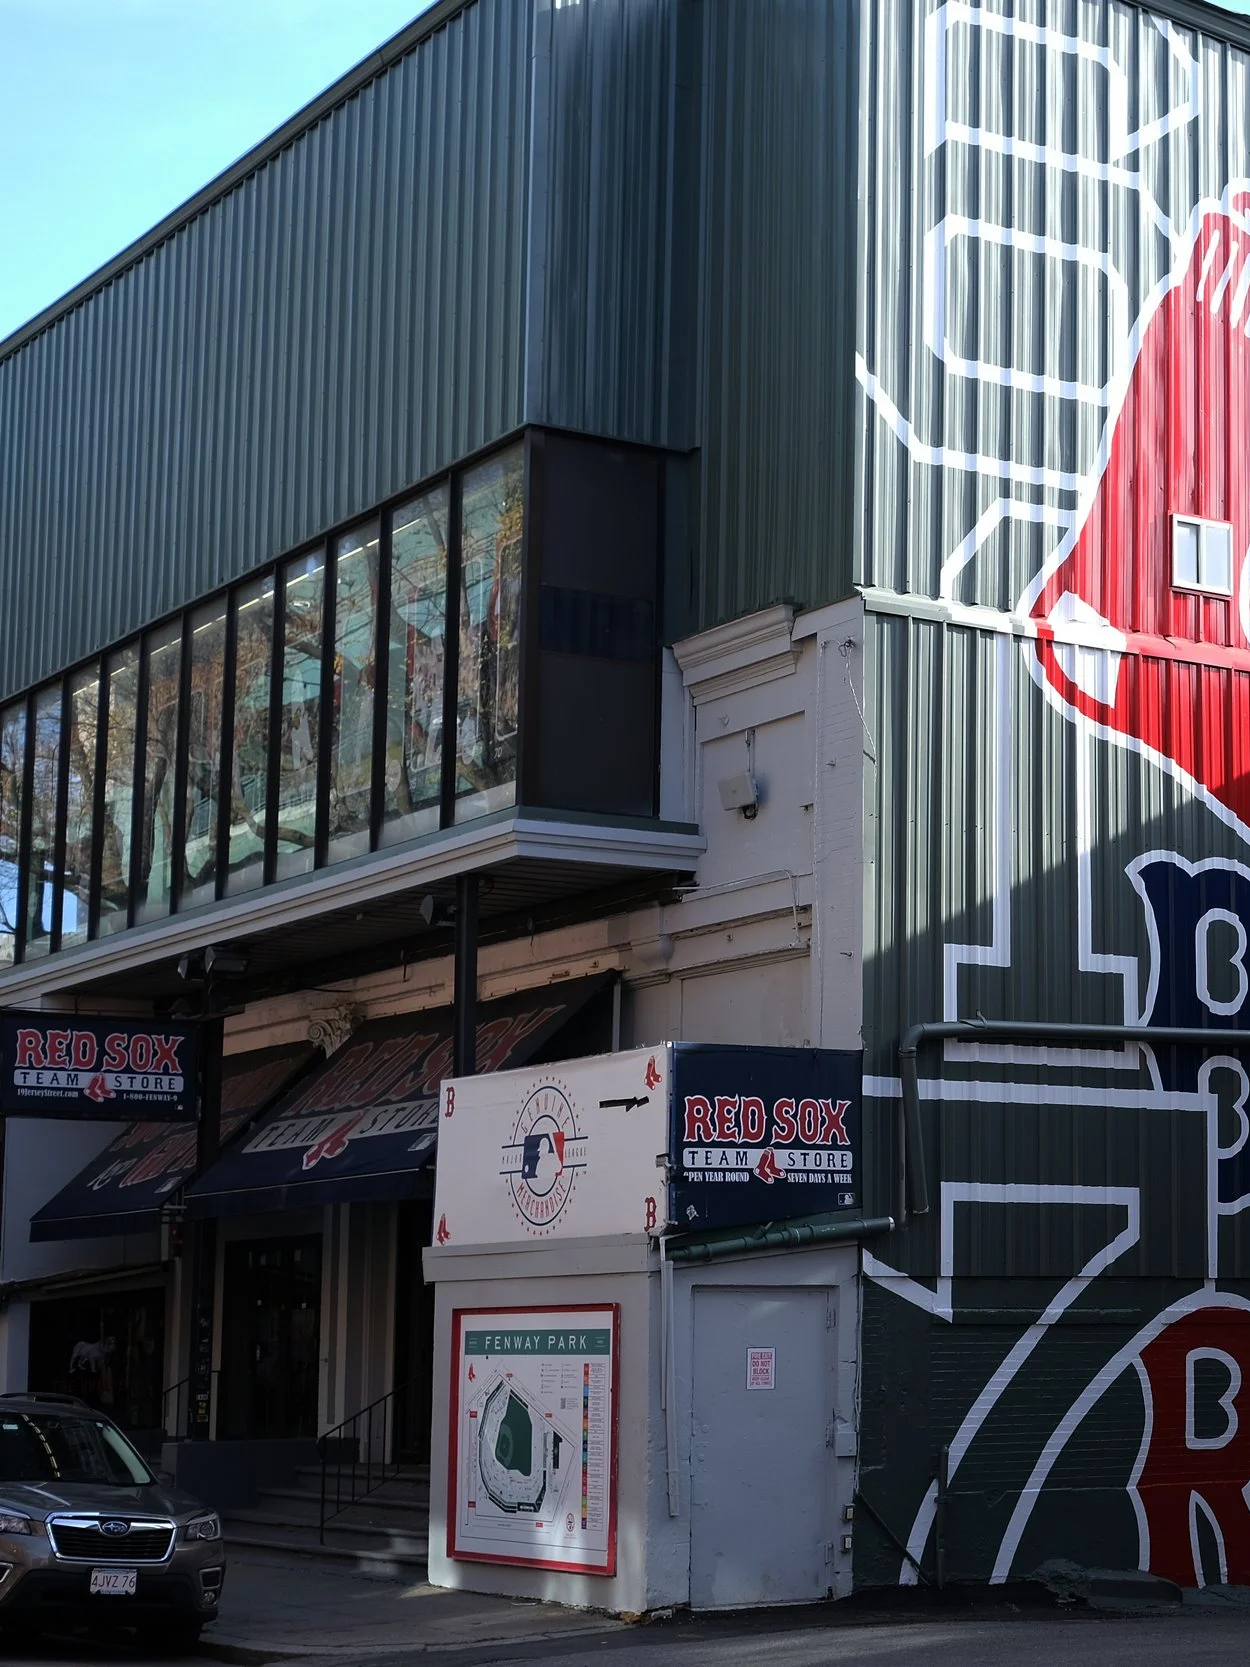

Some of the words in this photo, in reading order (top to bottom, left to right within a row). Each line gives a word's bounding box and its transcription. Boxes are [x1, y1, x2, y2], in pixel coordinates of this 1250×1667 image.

[14, 1028, 99, 1070] RED
[101, 1032, 185, 1074] SOX
[20, 1071, 79, 1087] TEAM
[114, 1075, 176, 1091] STORE
[17, 1088, 79, 1098] 19JerseyStreet.com
[520, 1094, 570, 1133] GENUINE
[683, 1094, 767, 1145] RED
[770, 1098, 852, 1145] SOX
[253, 1117, 337, 1150] TEAM
[501, 1153, 522, 1165] MAJOR
[565, 1147, 587, 1159] LEAGUE
[688, 1150, 748, 1166] TEAM
[787, 1152, 848, 1168] STORE
[705, 1171, 724, 1182] YEAR
[725, 1172, 750, 1183] ROUND
[787, 1174, 807, 1184] SEVEN
[808, 1174, 825, 1184] DAYS
[826, 1174, 832, 1184] A
[833, 1174, 852, 1184] WEEK
[516, 1182, 567, 1219] MERCHANDISE
[485, 1336, 541, 1350] FENWAY
[548, 1335, 587, 1350] PARK
[92, 1575, 119, 1588] 4JVZ
[122, 1575, 136, 1588] 76
